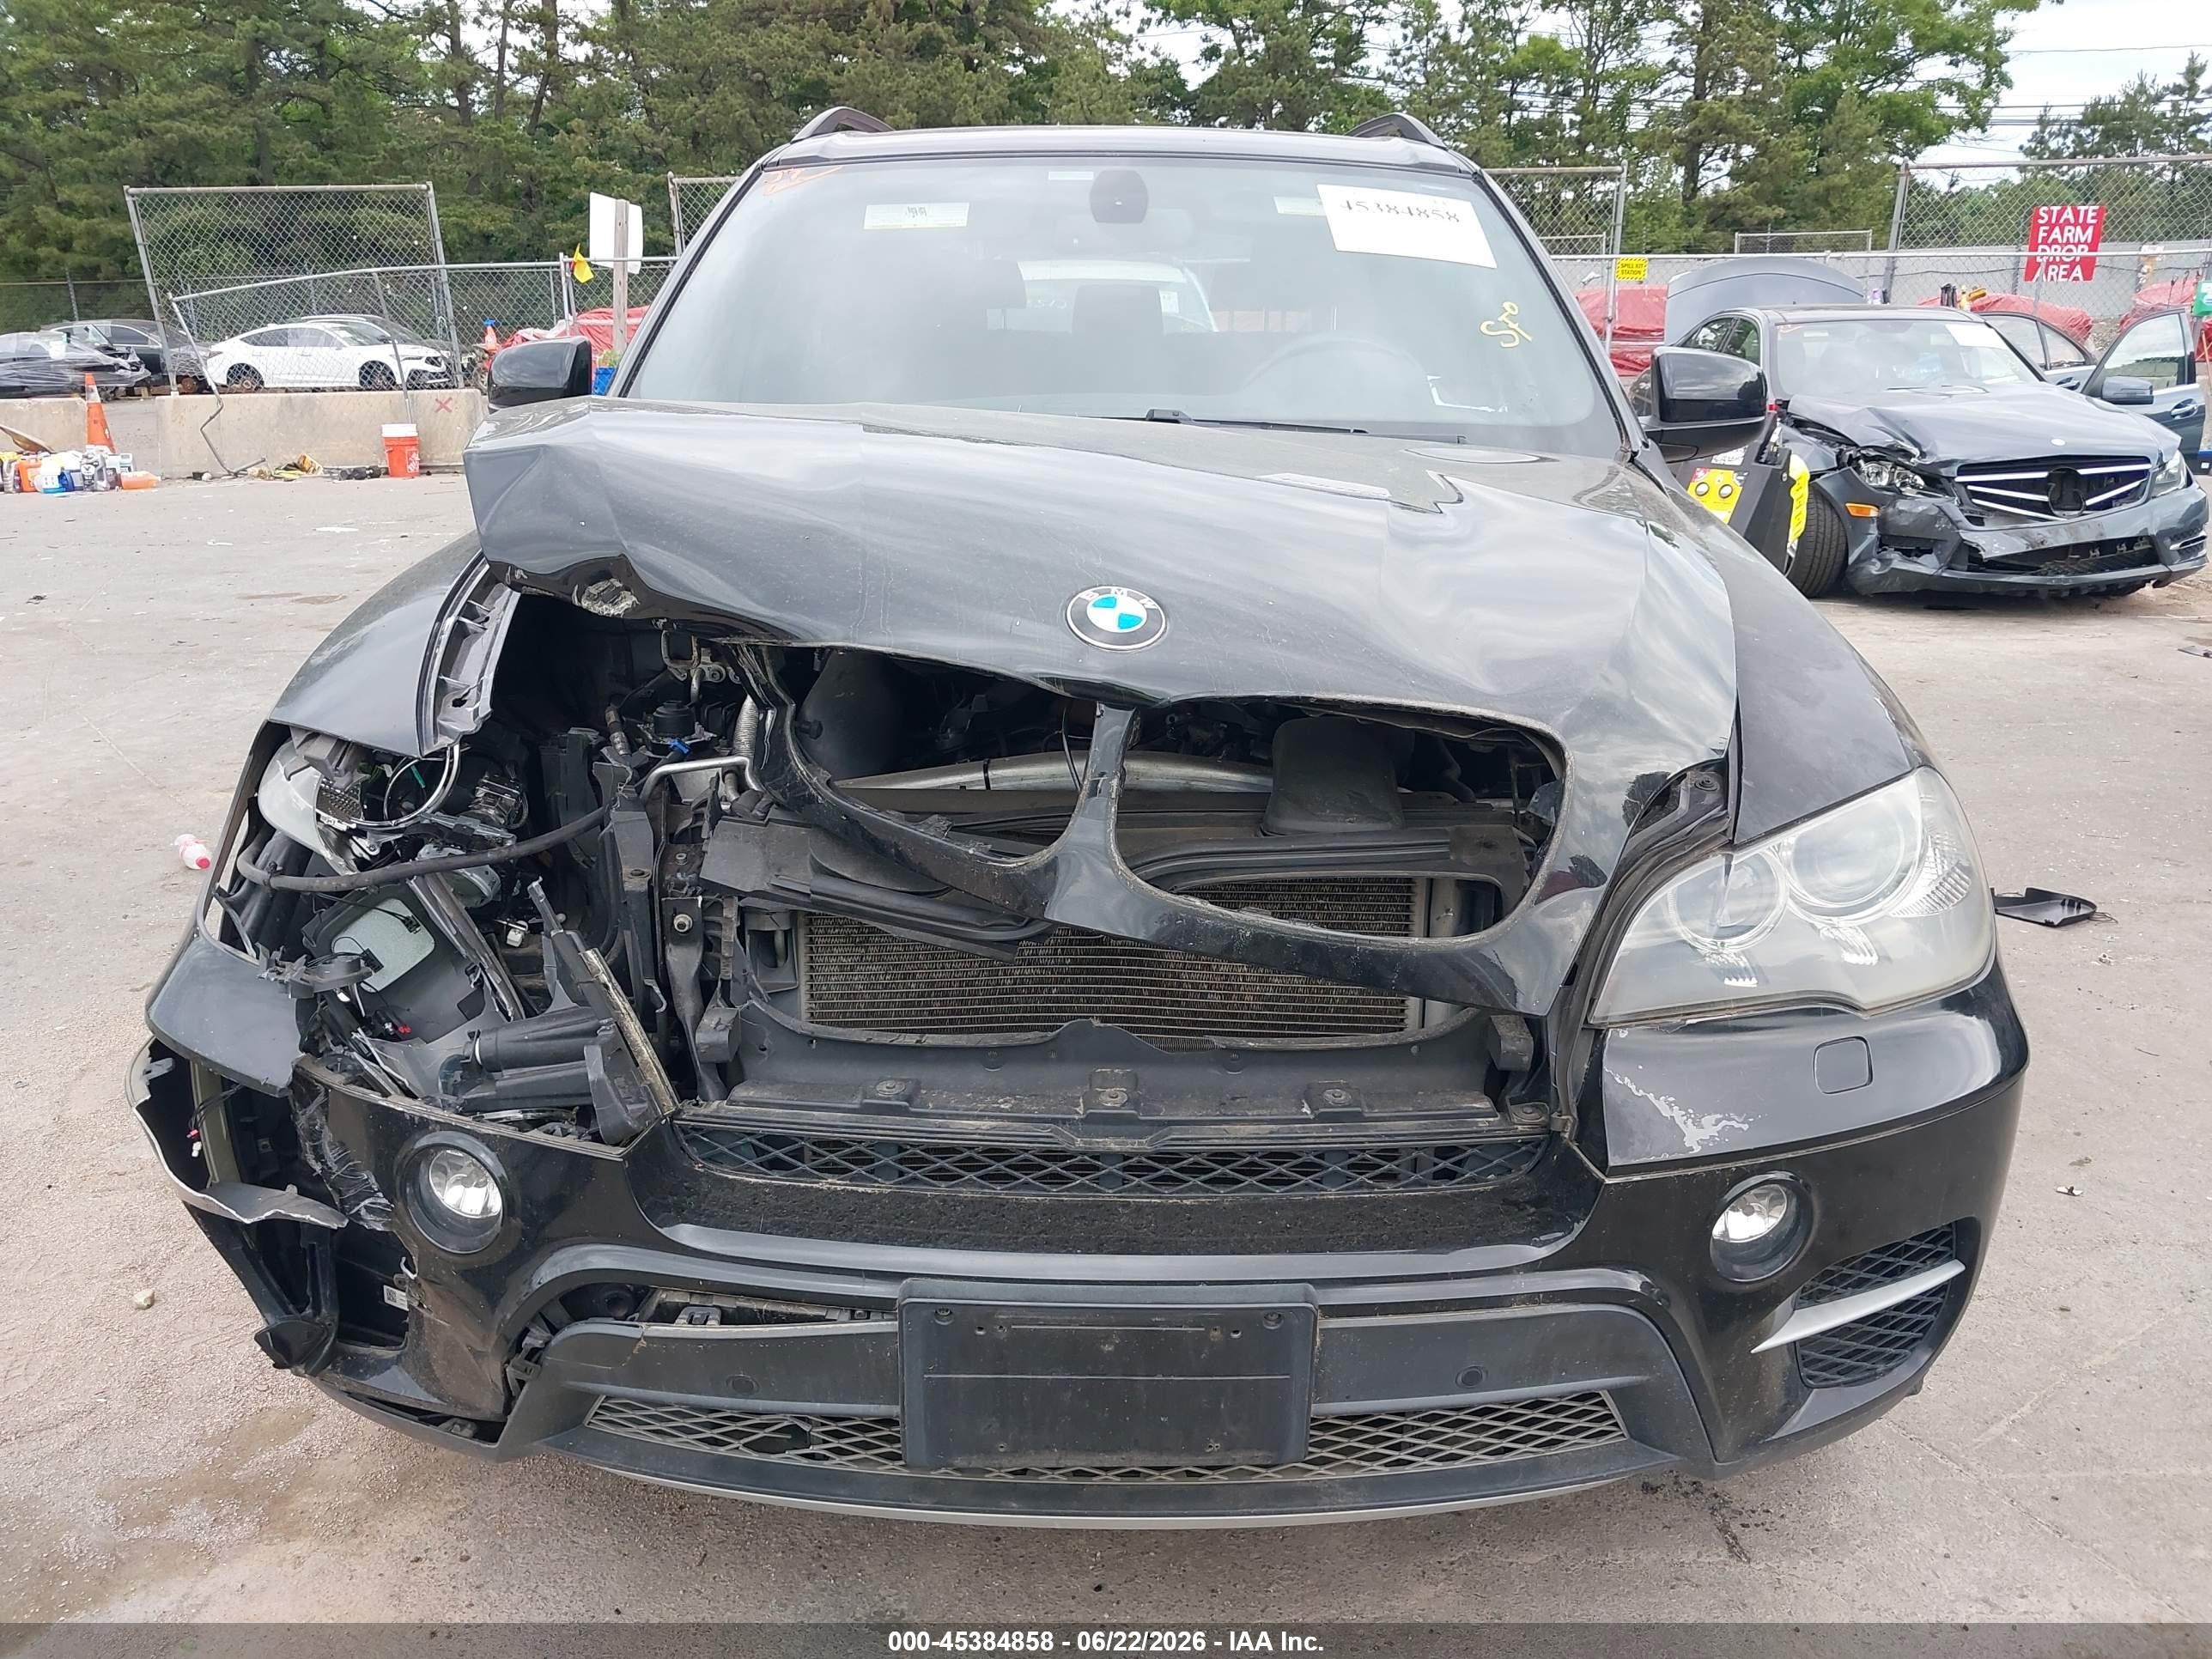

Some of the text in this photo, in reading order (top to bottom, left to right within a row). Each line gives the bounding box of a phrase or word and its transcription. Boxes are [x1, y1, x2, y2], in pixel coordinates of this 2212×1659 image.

[2037, 205, 2100, 224] STATE
[2038, 225, 2094, 244] FARM
[2036, 244, 2089, 263] DROP
[2032, 264, 2084, 283] AREA
[1079, 587, 1159, 610] BMW
